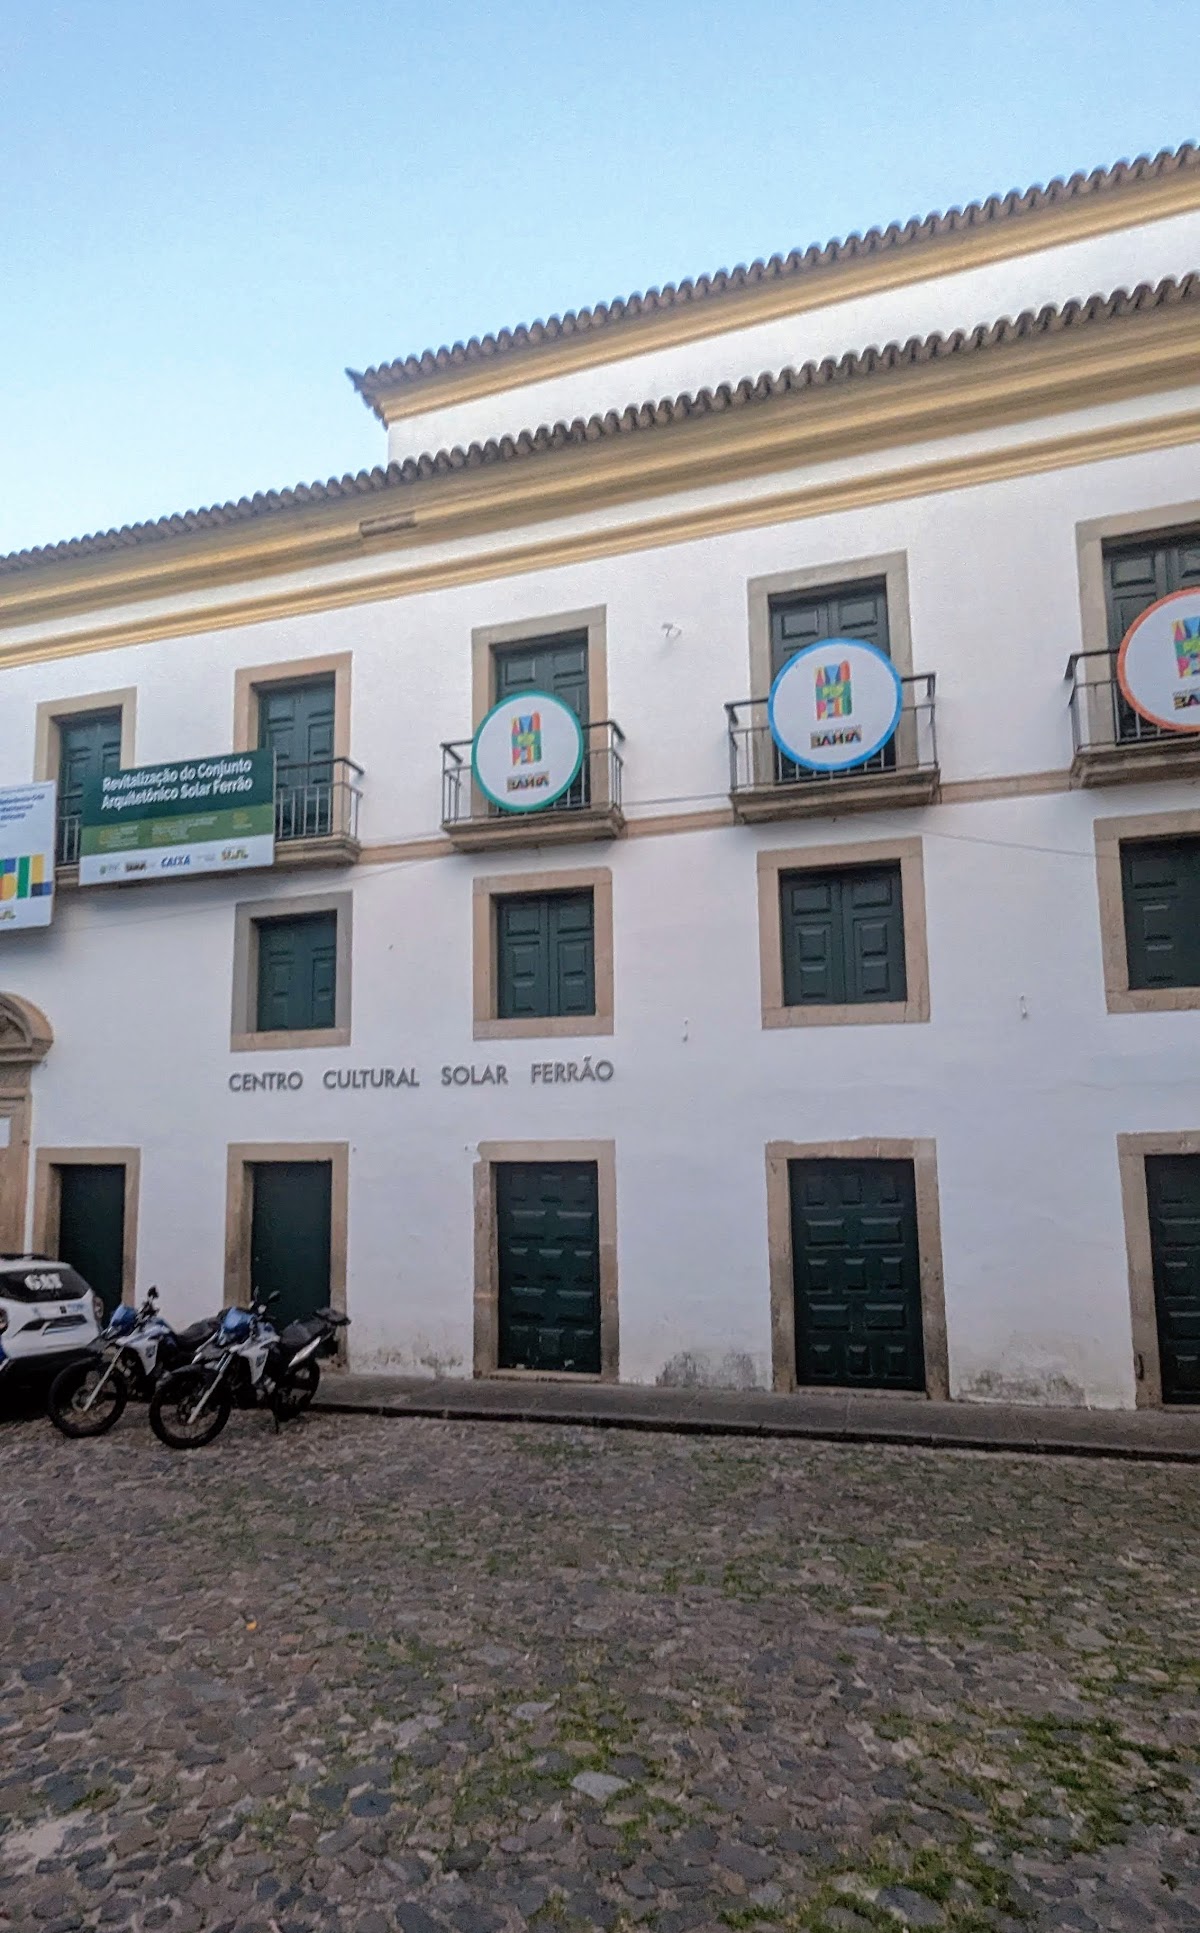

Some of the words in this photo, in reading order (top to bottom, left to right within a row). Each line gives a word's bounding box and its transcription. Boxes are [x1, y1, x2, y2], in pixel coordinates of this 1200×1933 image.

[102, 768, 178, 792] Revitalização
[179, 764, 196, 781] do
[197, 757, 253, 778] Conjunto
[101, 786, 179, 811] Arquitetônico
[180, 782, 212, 799] Solar
[212, 775, 253, 795] Ferrão
[161, 854, 191, 868] CAIXA
[228, 1071, 304, 1092] CENTRO
[322, 1068, 420, 1089] CULTURAL
[441, 1064, 508, 1086] SOLAR
[531, 1055, 614, 1084] FERRÃO
